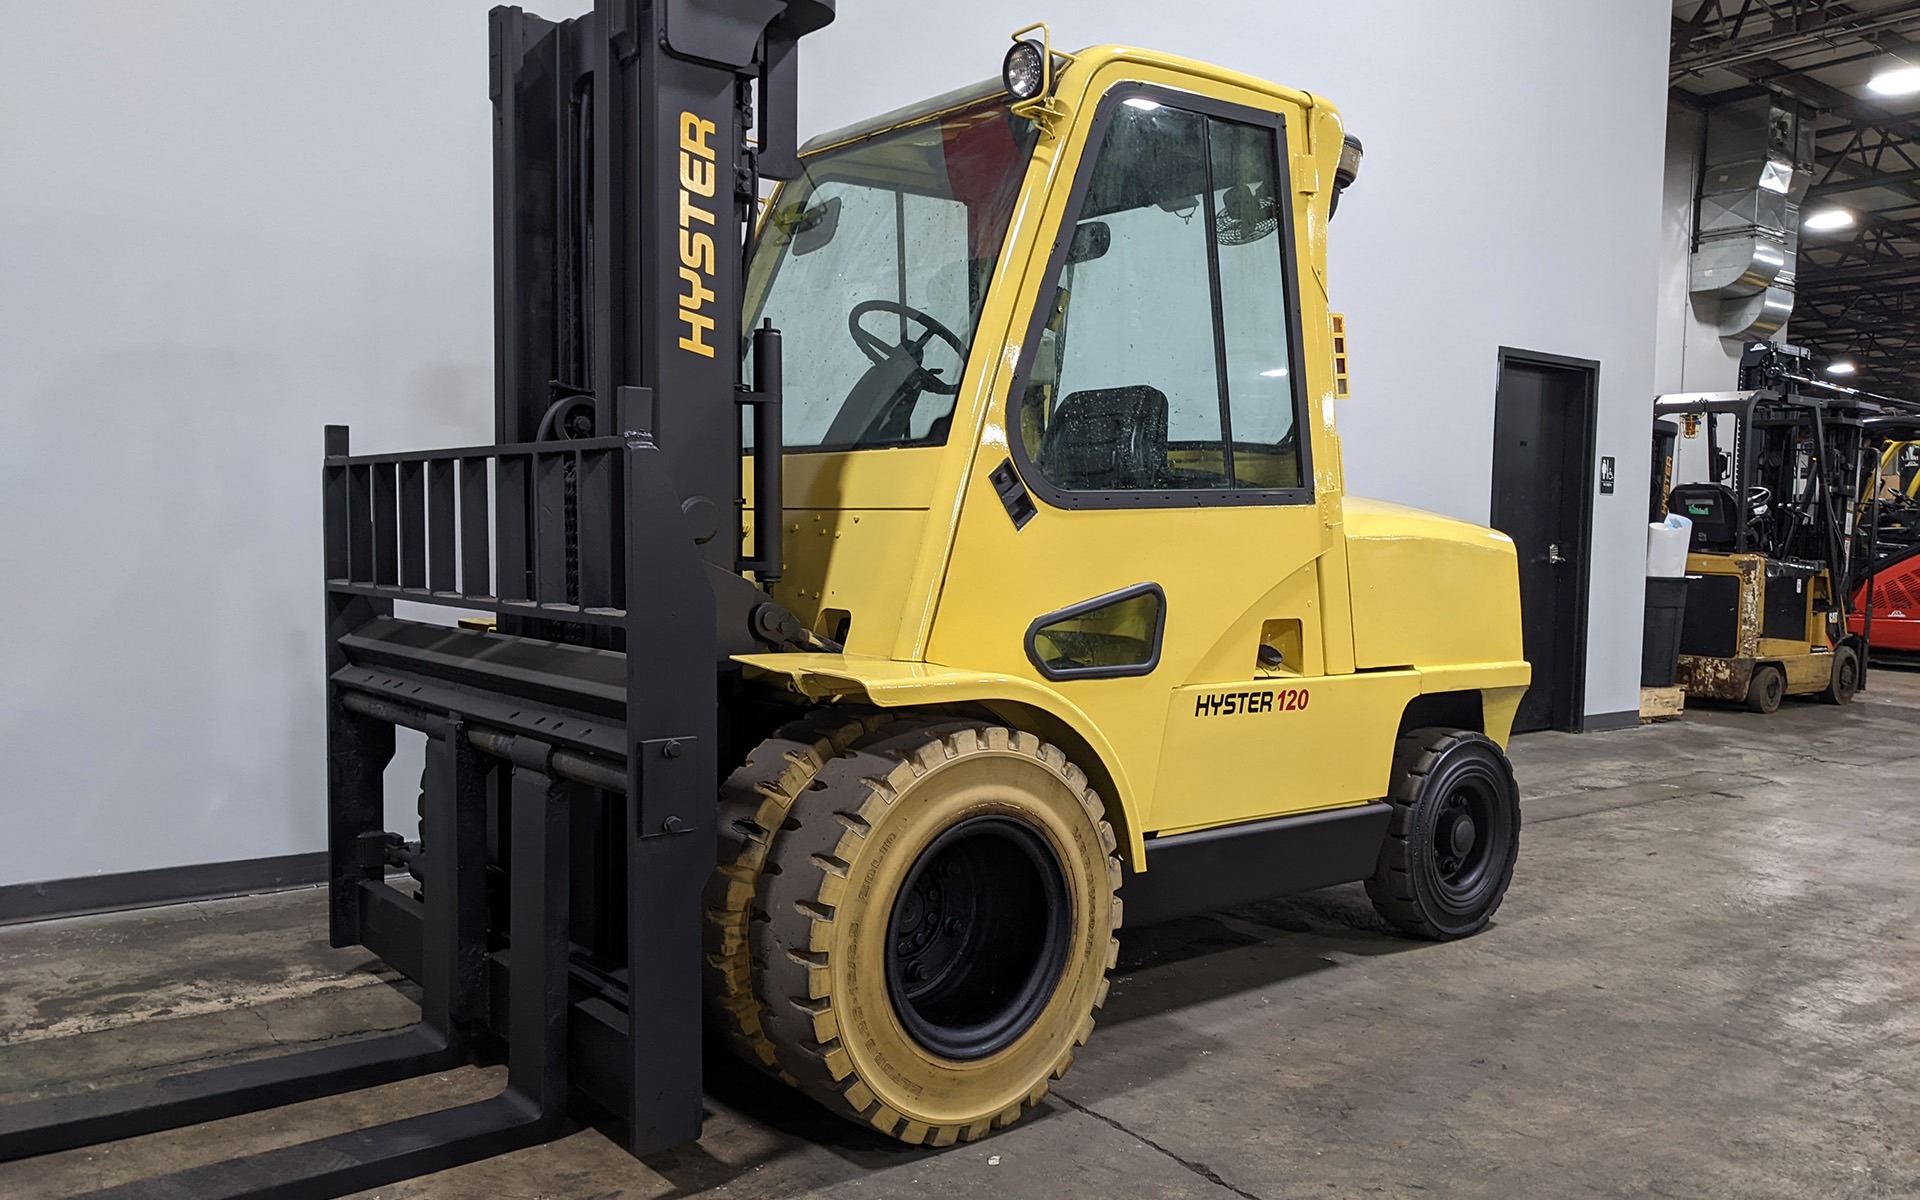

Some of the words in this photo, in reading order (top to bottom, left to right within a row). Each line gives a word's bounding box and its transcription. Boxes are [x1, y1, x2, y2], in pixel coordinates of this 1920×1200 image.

[679, 111, 716, 358] HYSTER
[1661, 455, 1672, 515] HYSTER
[1195, 691, 1274, 717] HYSTER
[1277, 689, 1309, 711] 120
